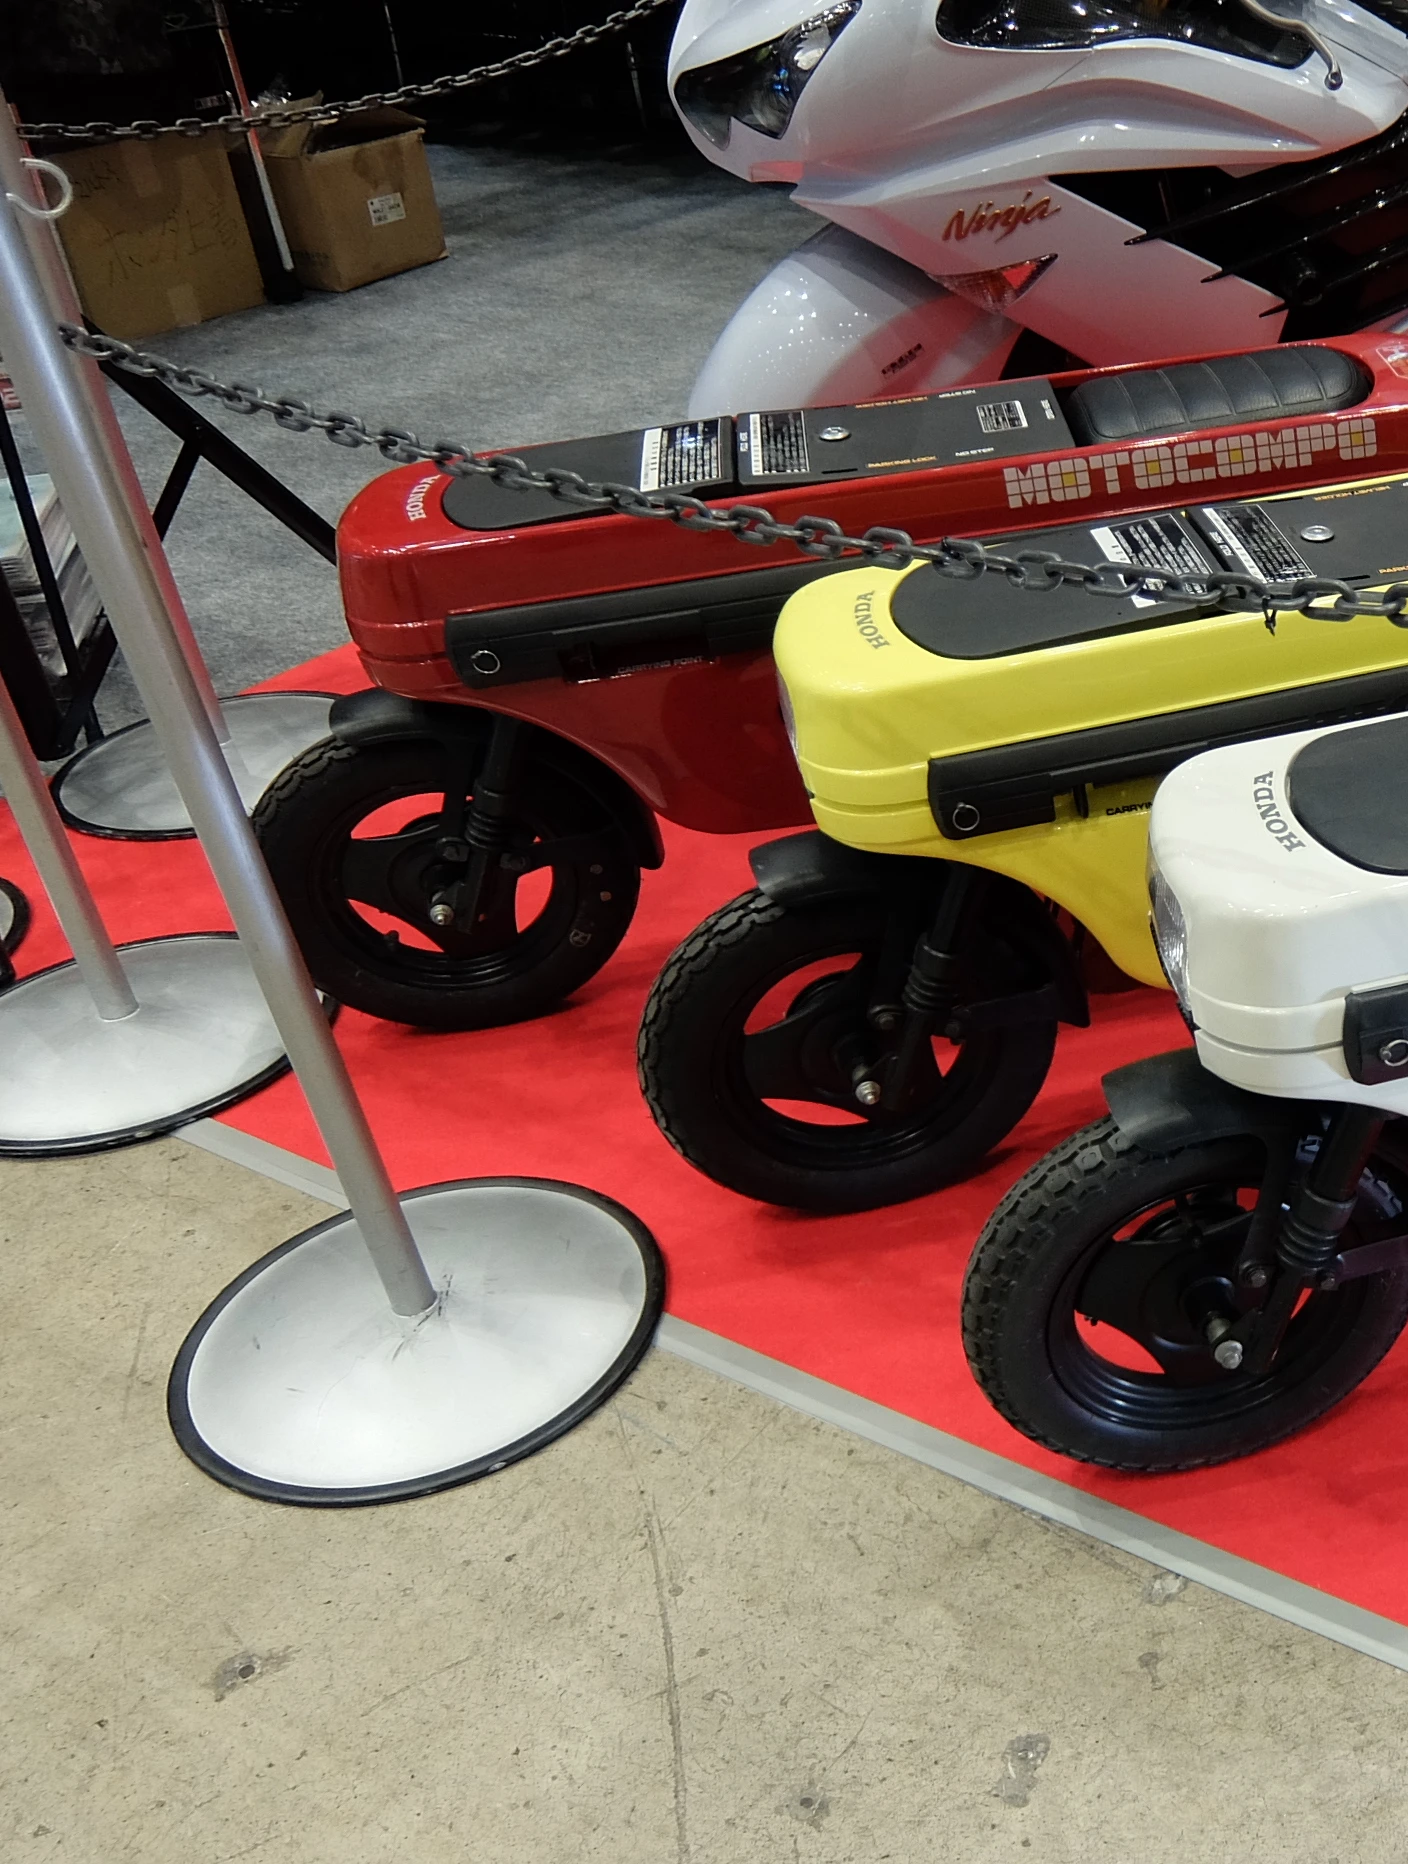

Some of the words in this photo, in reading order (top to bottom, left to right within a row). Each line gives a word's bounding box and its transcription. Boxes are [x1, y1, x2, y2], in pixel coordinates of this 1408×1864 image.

[942, 189, 1062, 244] Ninja
[867, 457, 911, 469] PARKING
[911, 455, 938, 464] LOCK
[1003, 417, 1378, 509] MOTOCOMPO
[405, 474, 442, 522] HONDA
[854, 589, 891, 650] HONDA
[617, 660, 671, 674] CARRYING
[673, 655, 704, 666] POINT
[1252, 770, 1307, 853] HONDA
